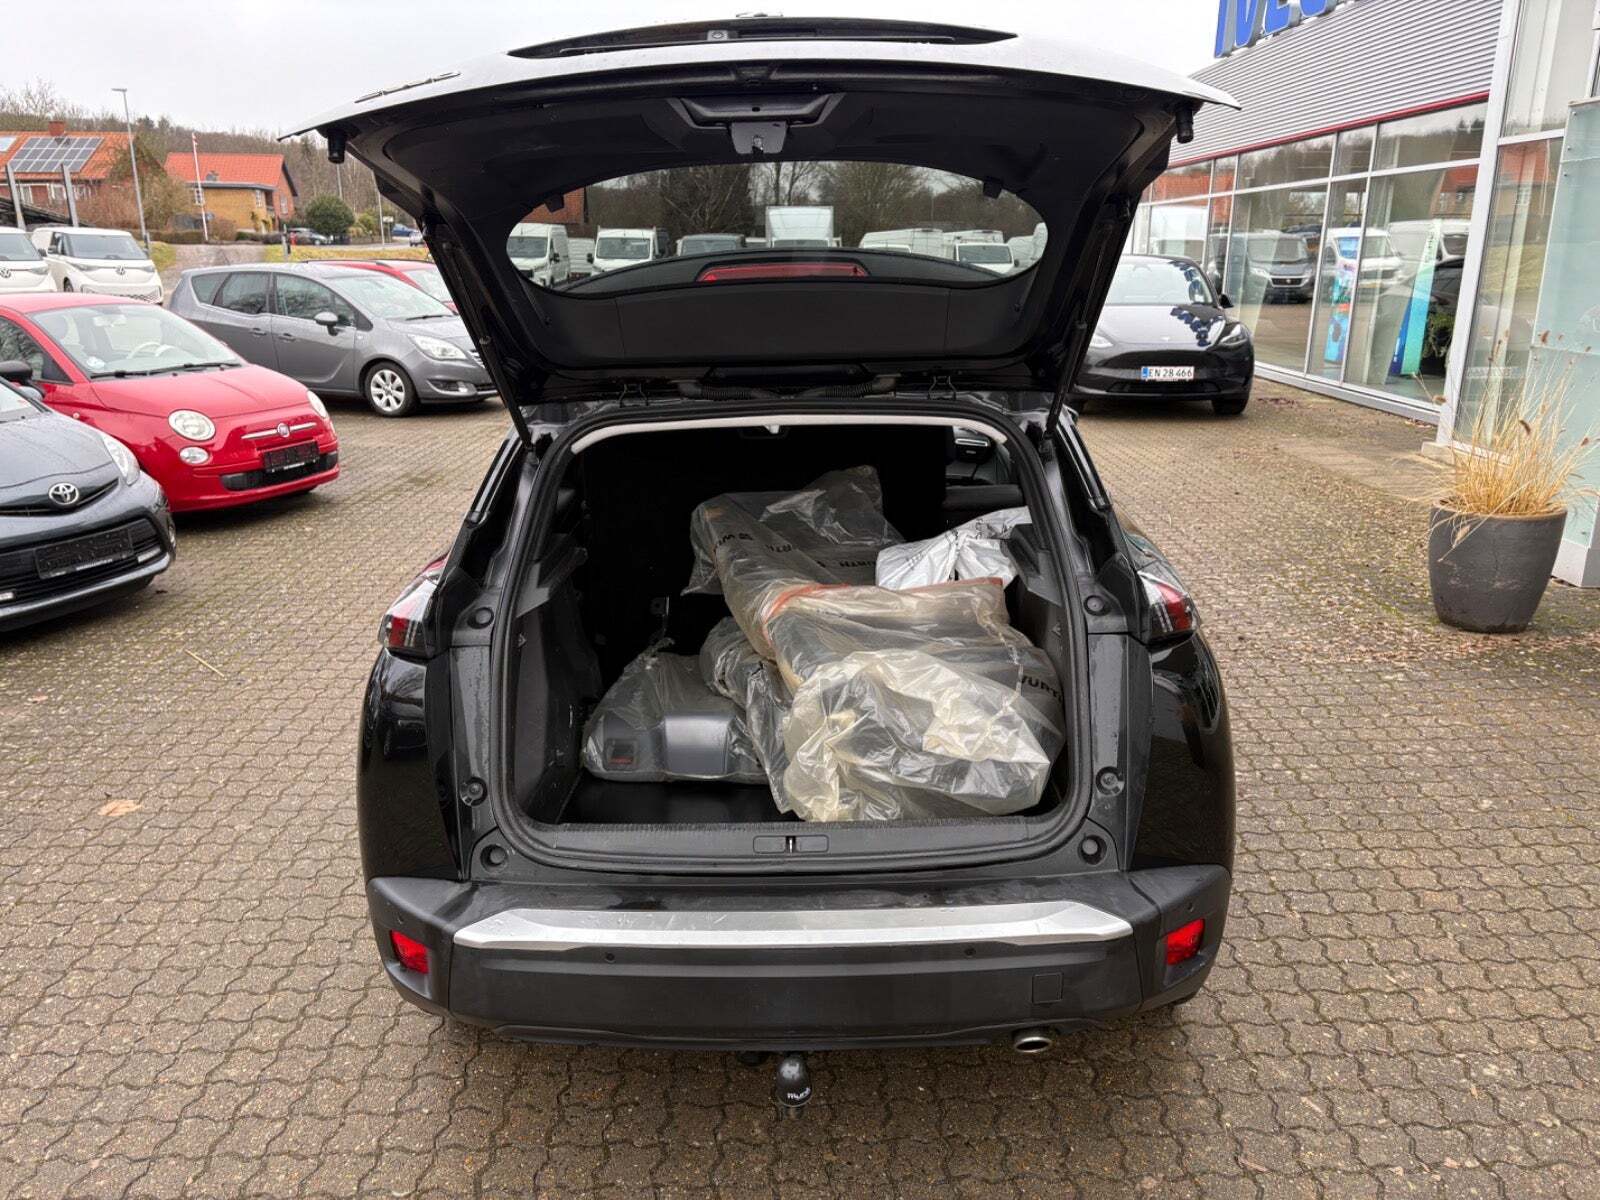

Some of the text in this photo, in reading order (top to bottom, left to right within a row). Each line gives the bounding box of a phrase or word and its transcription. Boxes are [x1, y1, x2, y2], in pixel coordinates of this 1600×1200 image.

[1215, 0, 1340, 58] IV
[1149, 368, 1193, 377] EN 28 466
